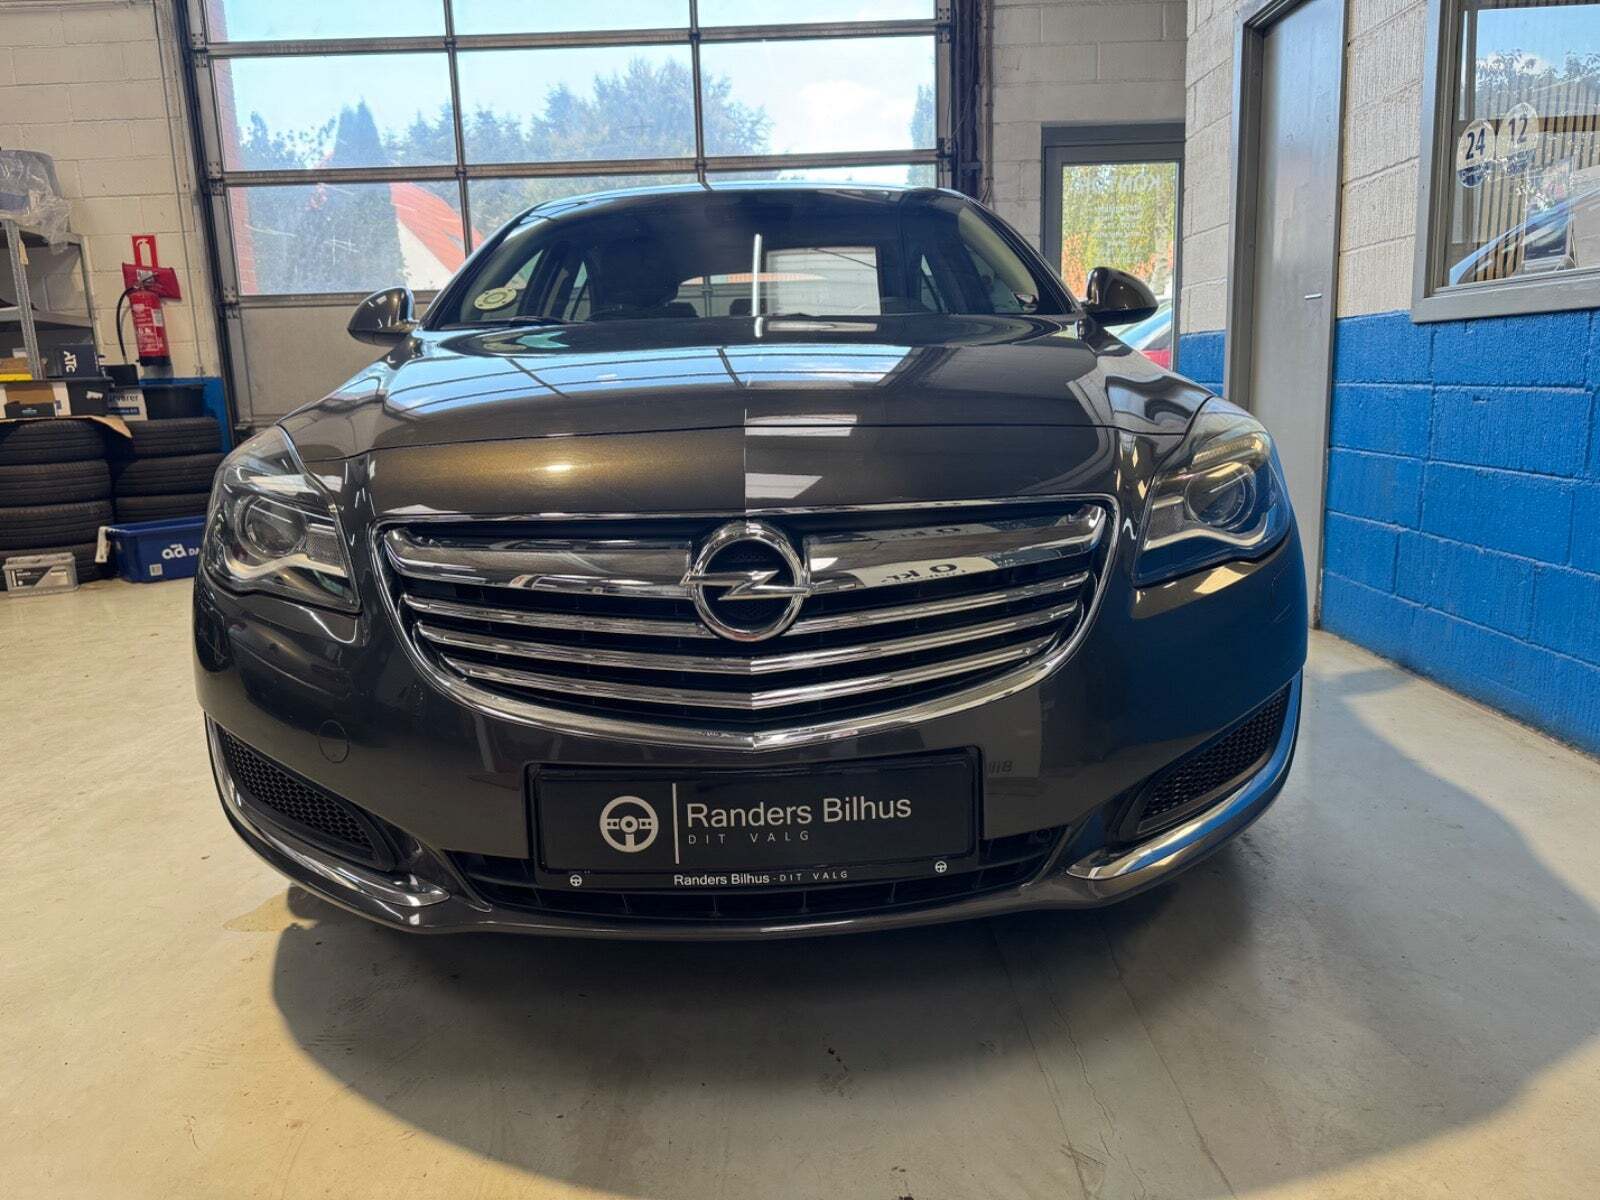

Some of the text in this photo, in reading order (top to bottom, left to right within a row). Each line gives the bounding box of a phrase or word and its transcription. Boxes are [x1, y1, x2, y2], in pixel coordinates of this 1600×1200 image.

[1466, 128, 1486, 160] 24
[1508, 114, 1528, 144] 12
[687, 796, 912, 828] Randers Bilhus
[688, 830, 809, 845] DIT VALG
[673, 873, 727, 886] Randers
[731, 873, 770, 885] Bilhus
[779, 873, 802, 882] DIT
[812, 870, 848, 881] VALG
